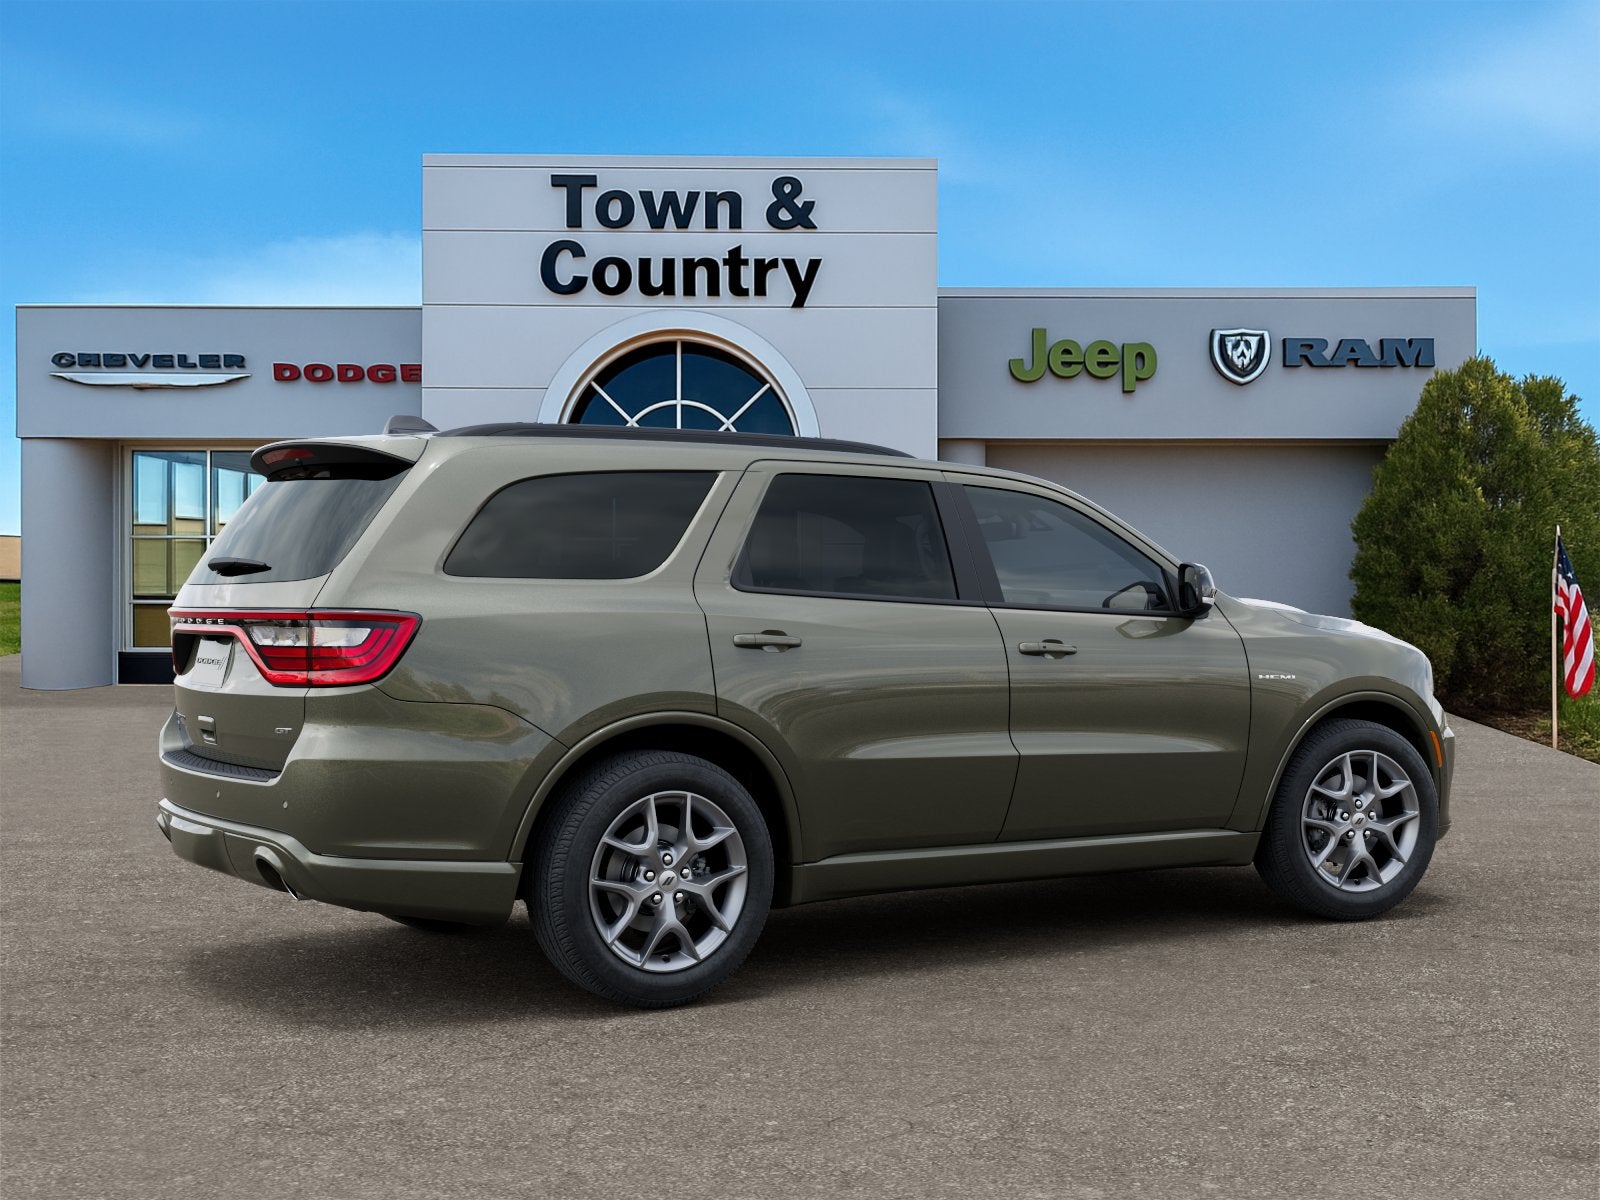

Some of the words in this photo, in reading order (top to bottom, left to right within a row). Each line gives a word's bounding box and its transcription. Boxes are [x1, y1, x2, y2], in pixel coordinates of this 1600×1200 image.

[550, 174, 743, 230] Town
[765, 175, 818, 230] &
[540, 239, 823, 308] Country
[272, 362, 422, 384] DODGE
[1008, 327, 1158, 393] Jeep
[1282, 337, 1436, 368] RAM
